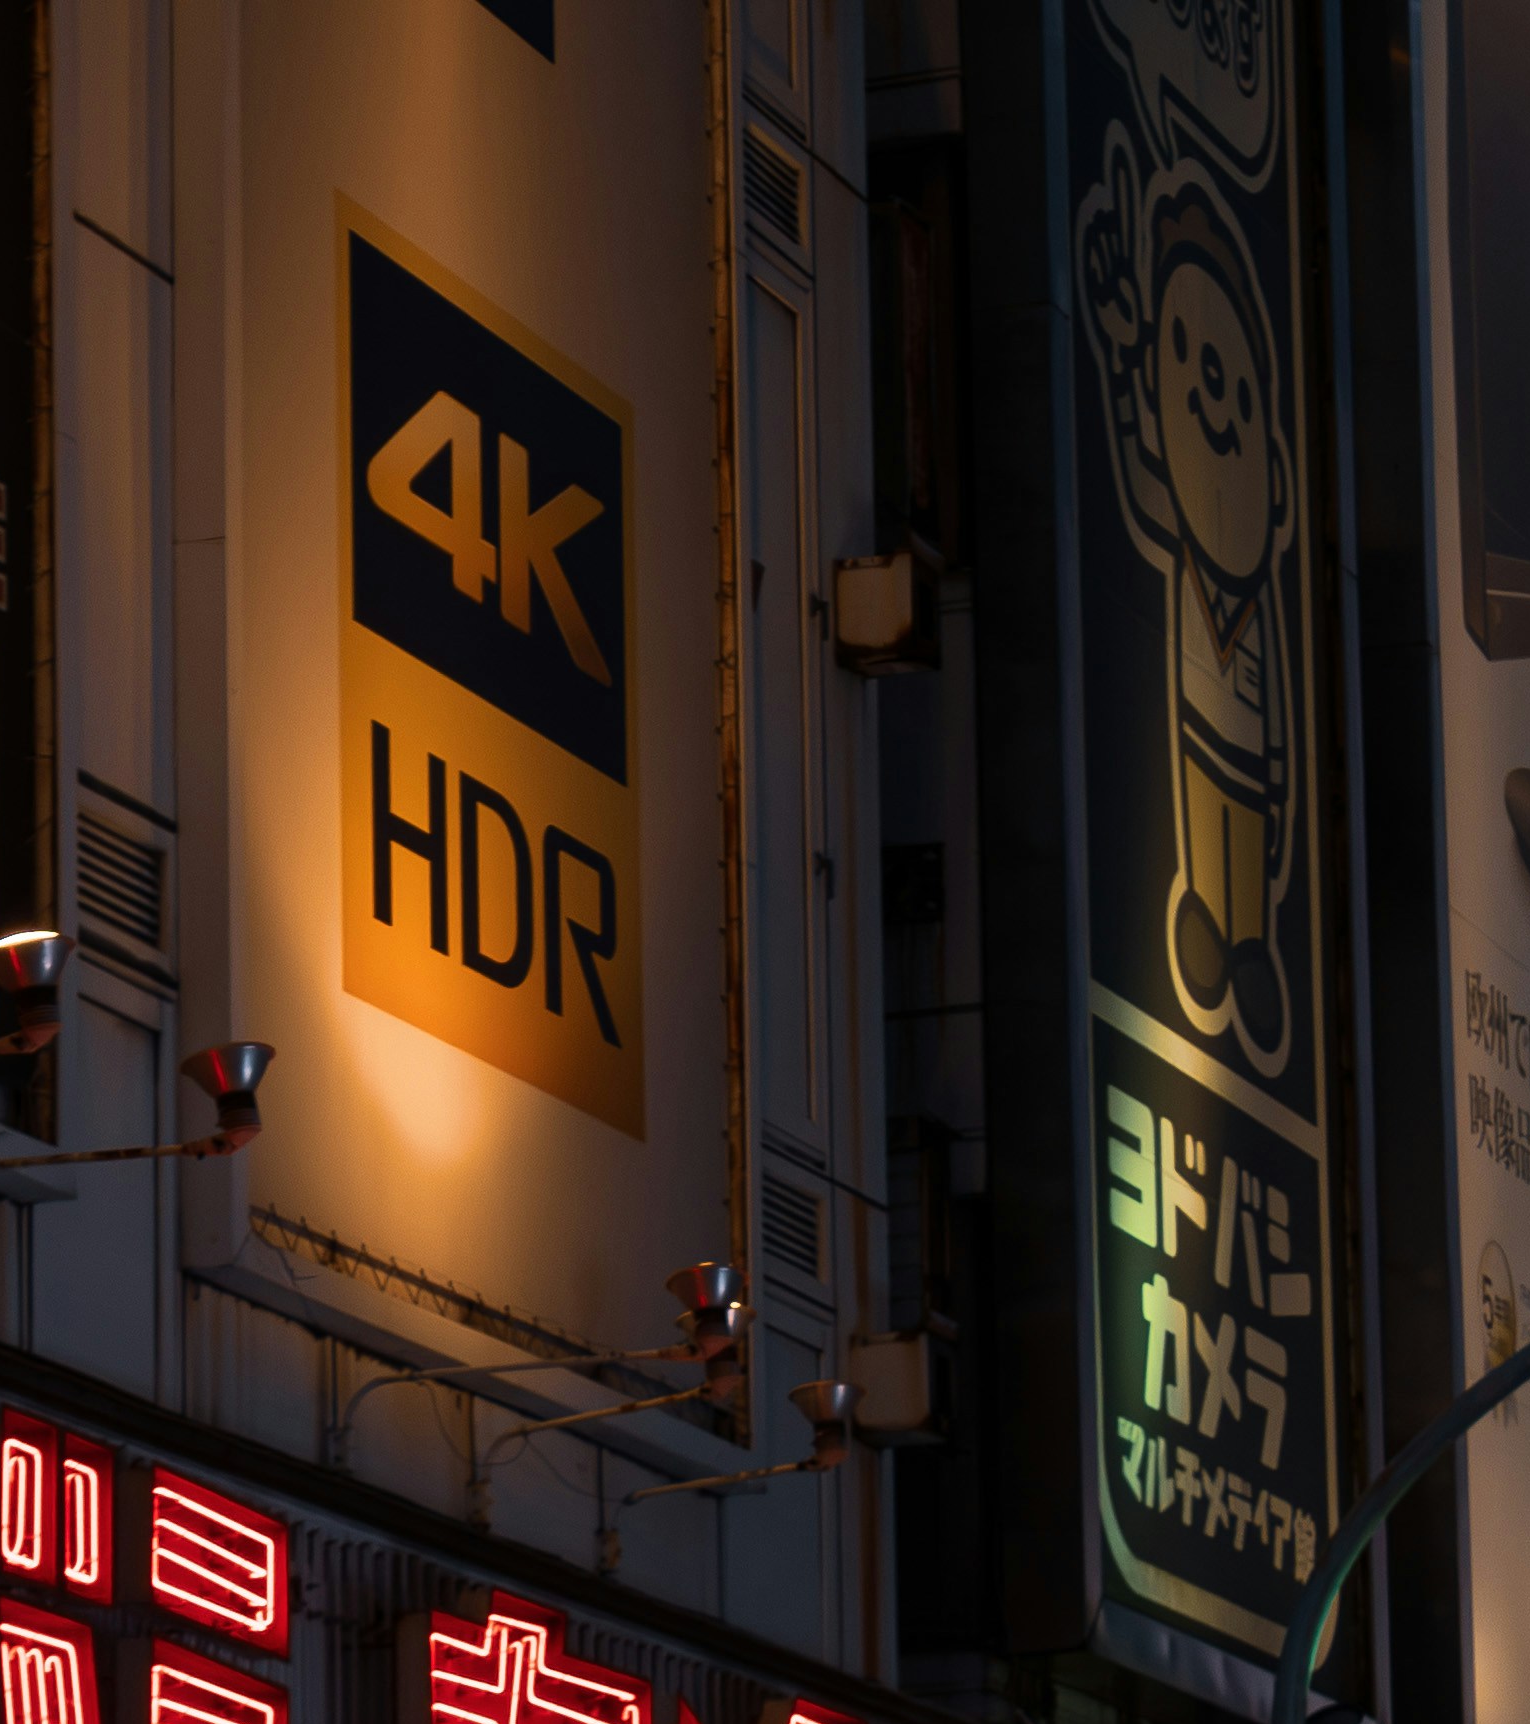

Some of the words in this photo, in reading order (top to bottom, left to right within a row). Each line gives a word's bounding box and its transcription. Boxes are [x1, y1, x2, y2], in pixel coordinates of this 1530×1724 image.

[366, 389, 612, 690] 4K
[369, 717, 622, 1050] HDR
[1106, 1082, 1314, 1318] ヨドバシ
[1141, 1270, 1289, 1471] カメラ
